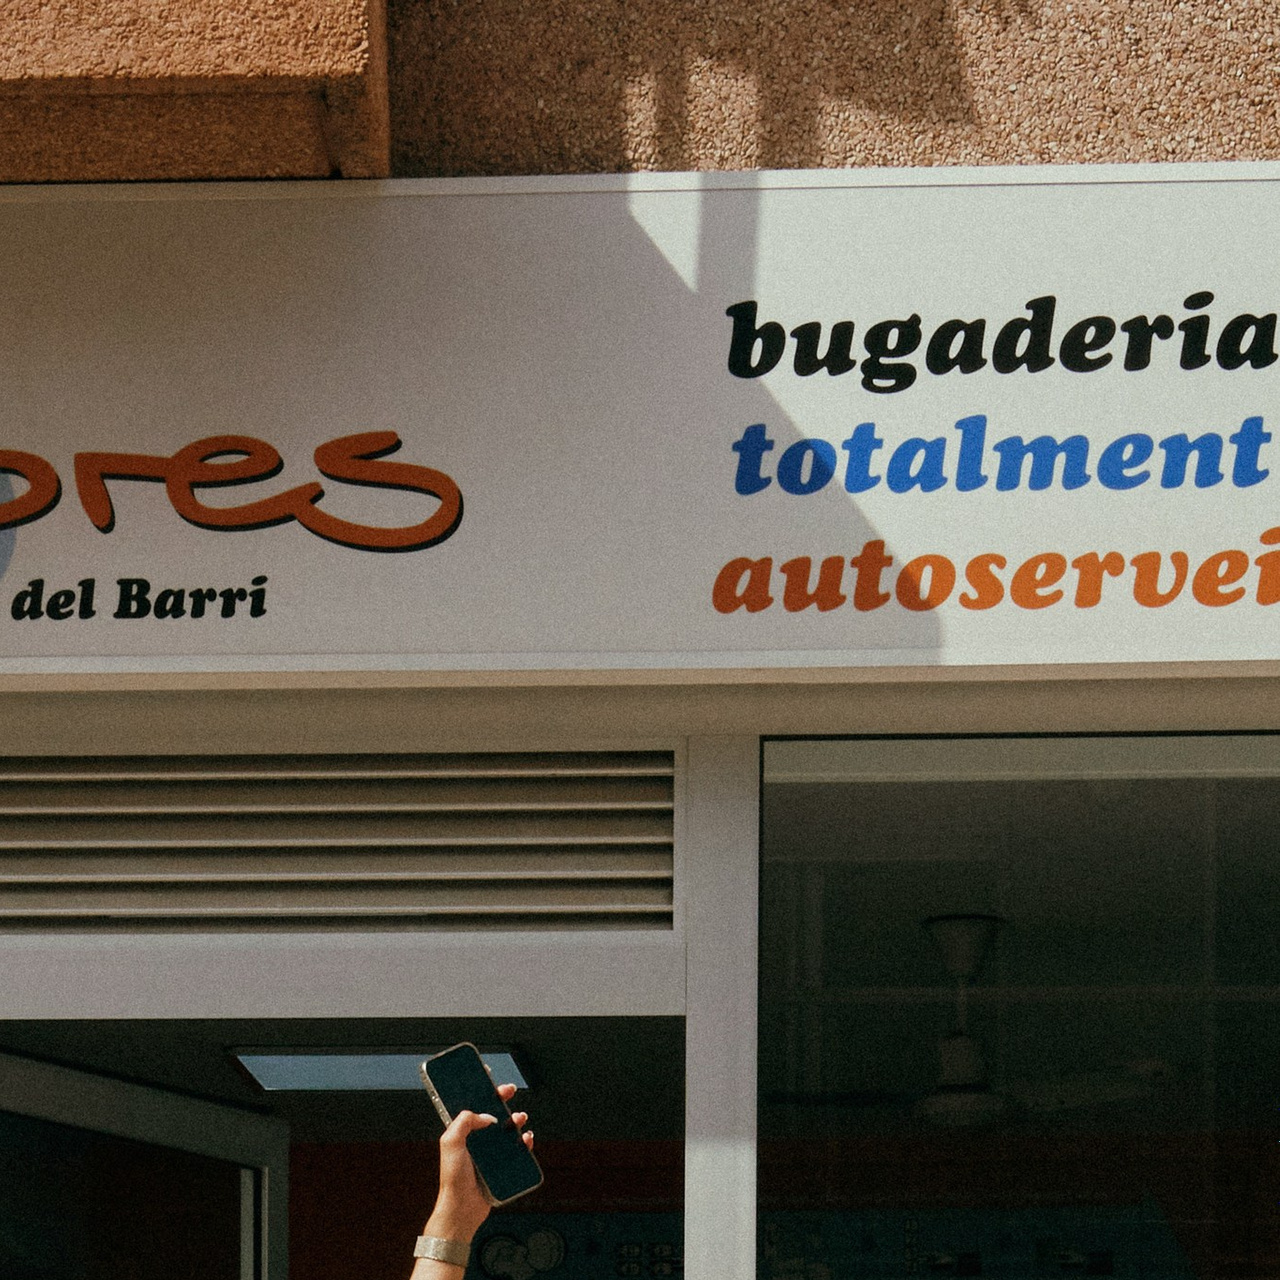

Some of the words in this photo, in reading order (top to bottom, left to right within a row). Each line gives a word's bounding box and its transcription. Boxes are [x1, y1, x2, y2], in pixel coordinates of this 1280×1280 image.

[725, 291, 1278, 393] bugaderia
[732, 414, 1272, 496] totalment
[10, 578, 95, 620] del
[113, 576, 268, 619] Barri
[711, 526, 1280, 614] autoservei
